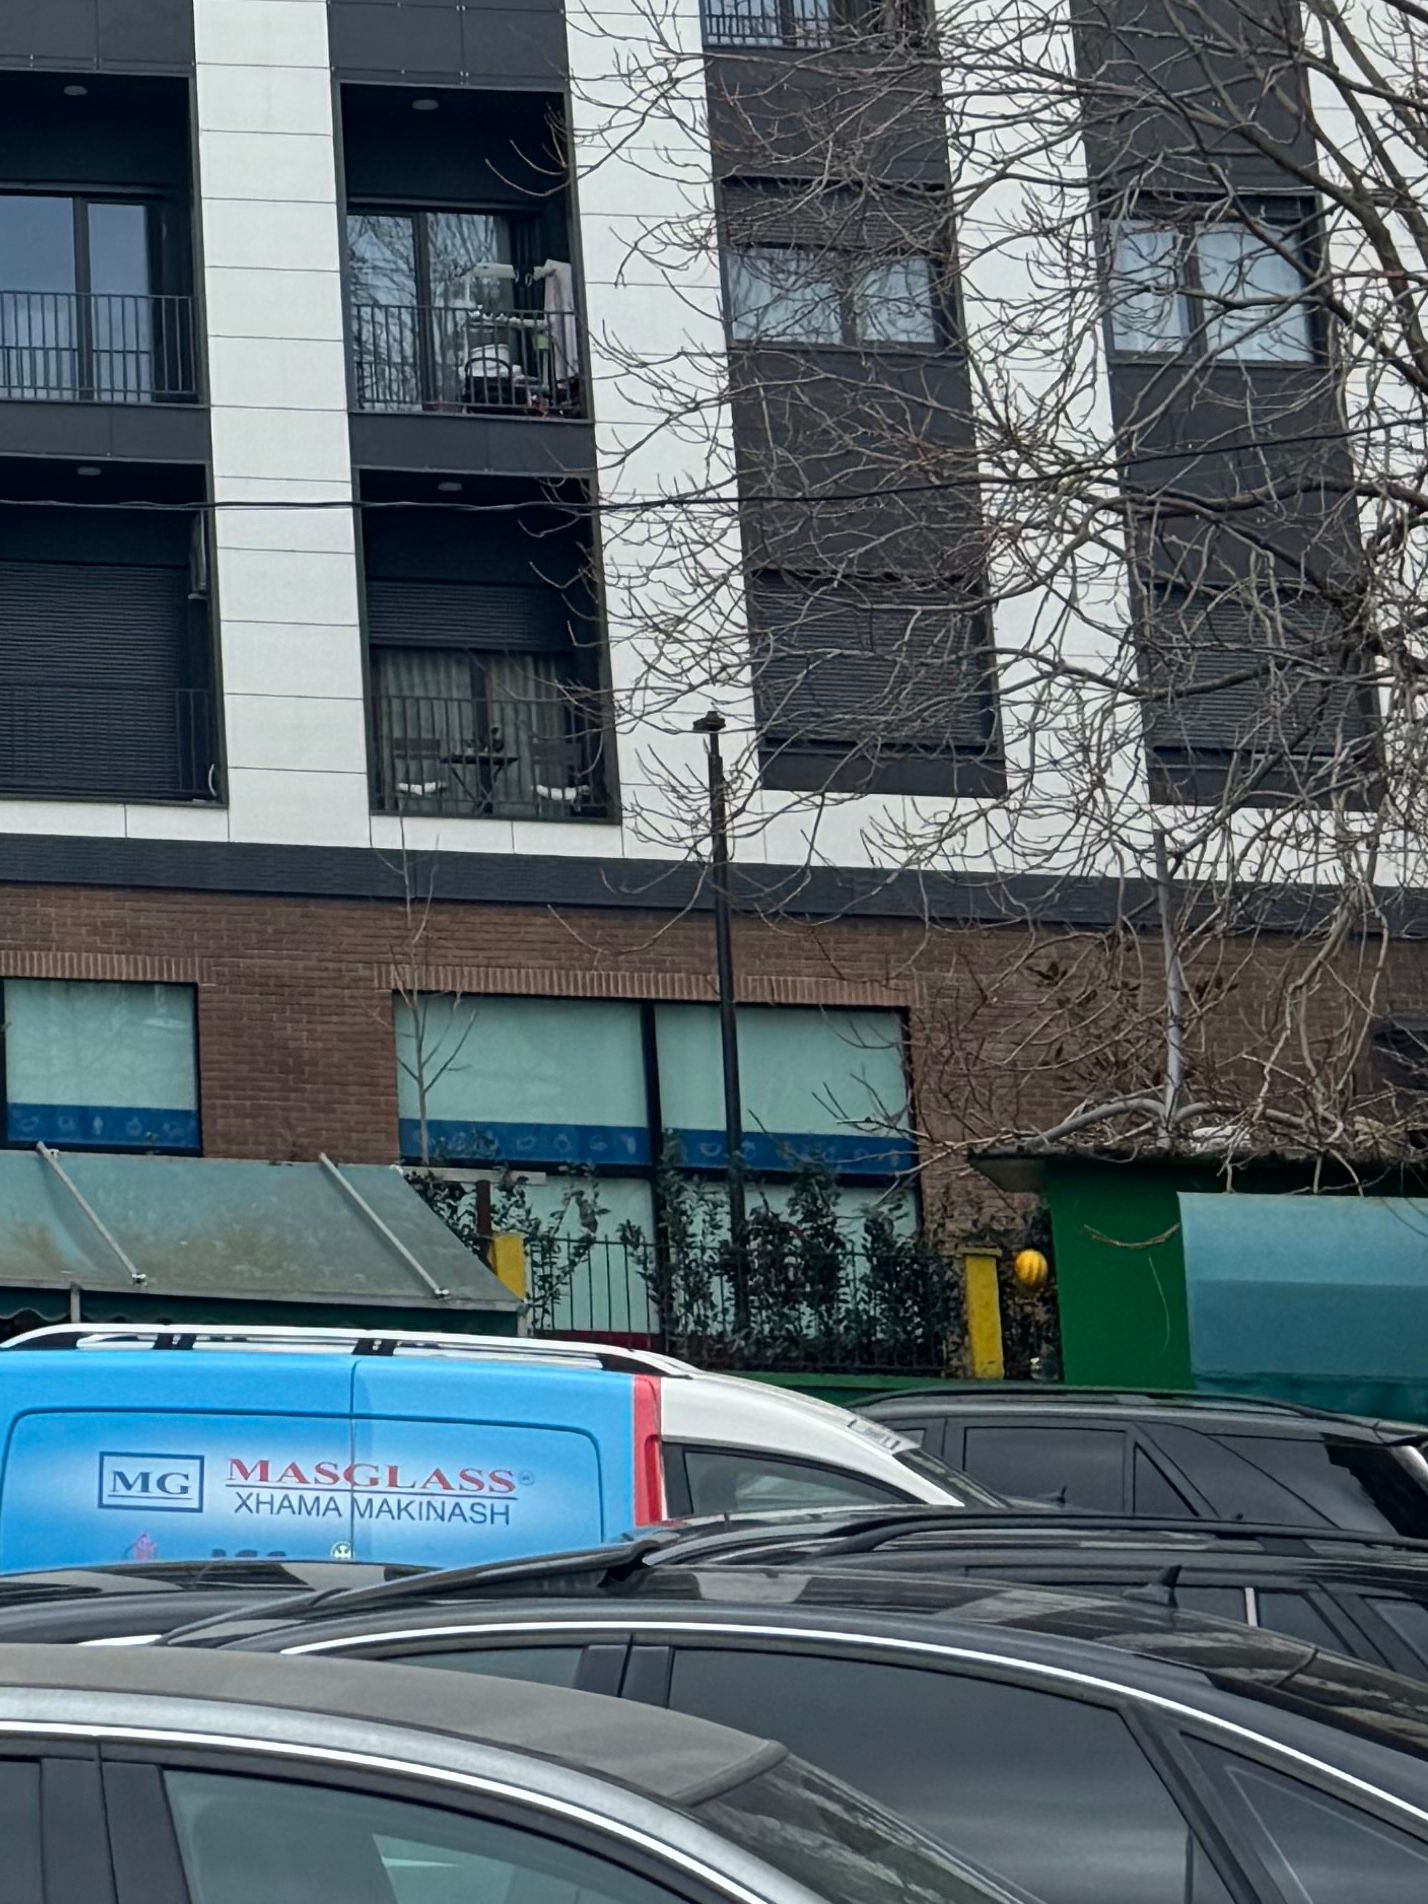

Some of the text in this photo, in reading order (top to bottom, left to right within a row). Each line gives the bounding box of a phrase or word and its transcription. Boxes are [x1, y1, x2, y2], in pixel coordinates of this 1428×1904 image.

[111, 1469, 191, 1496] MG
[228, 1456, 517, 1494] MASGLASS
[233, 1492, 511, 1527] XHAMA MAKINASH
